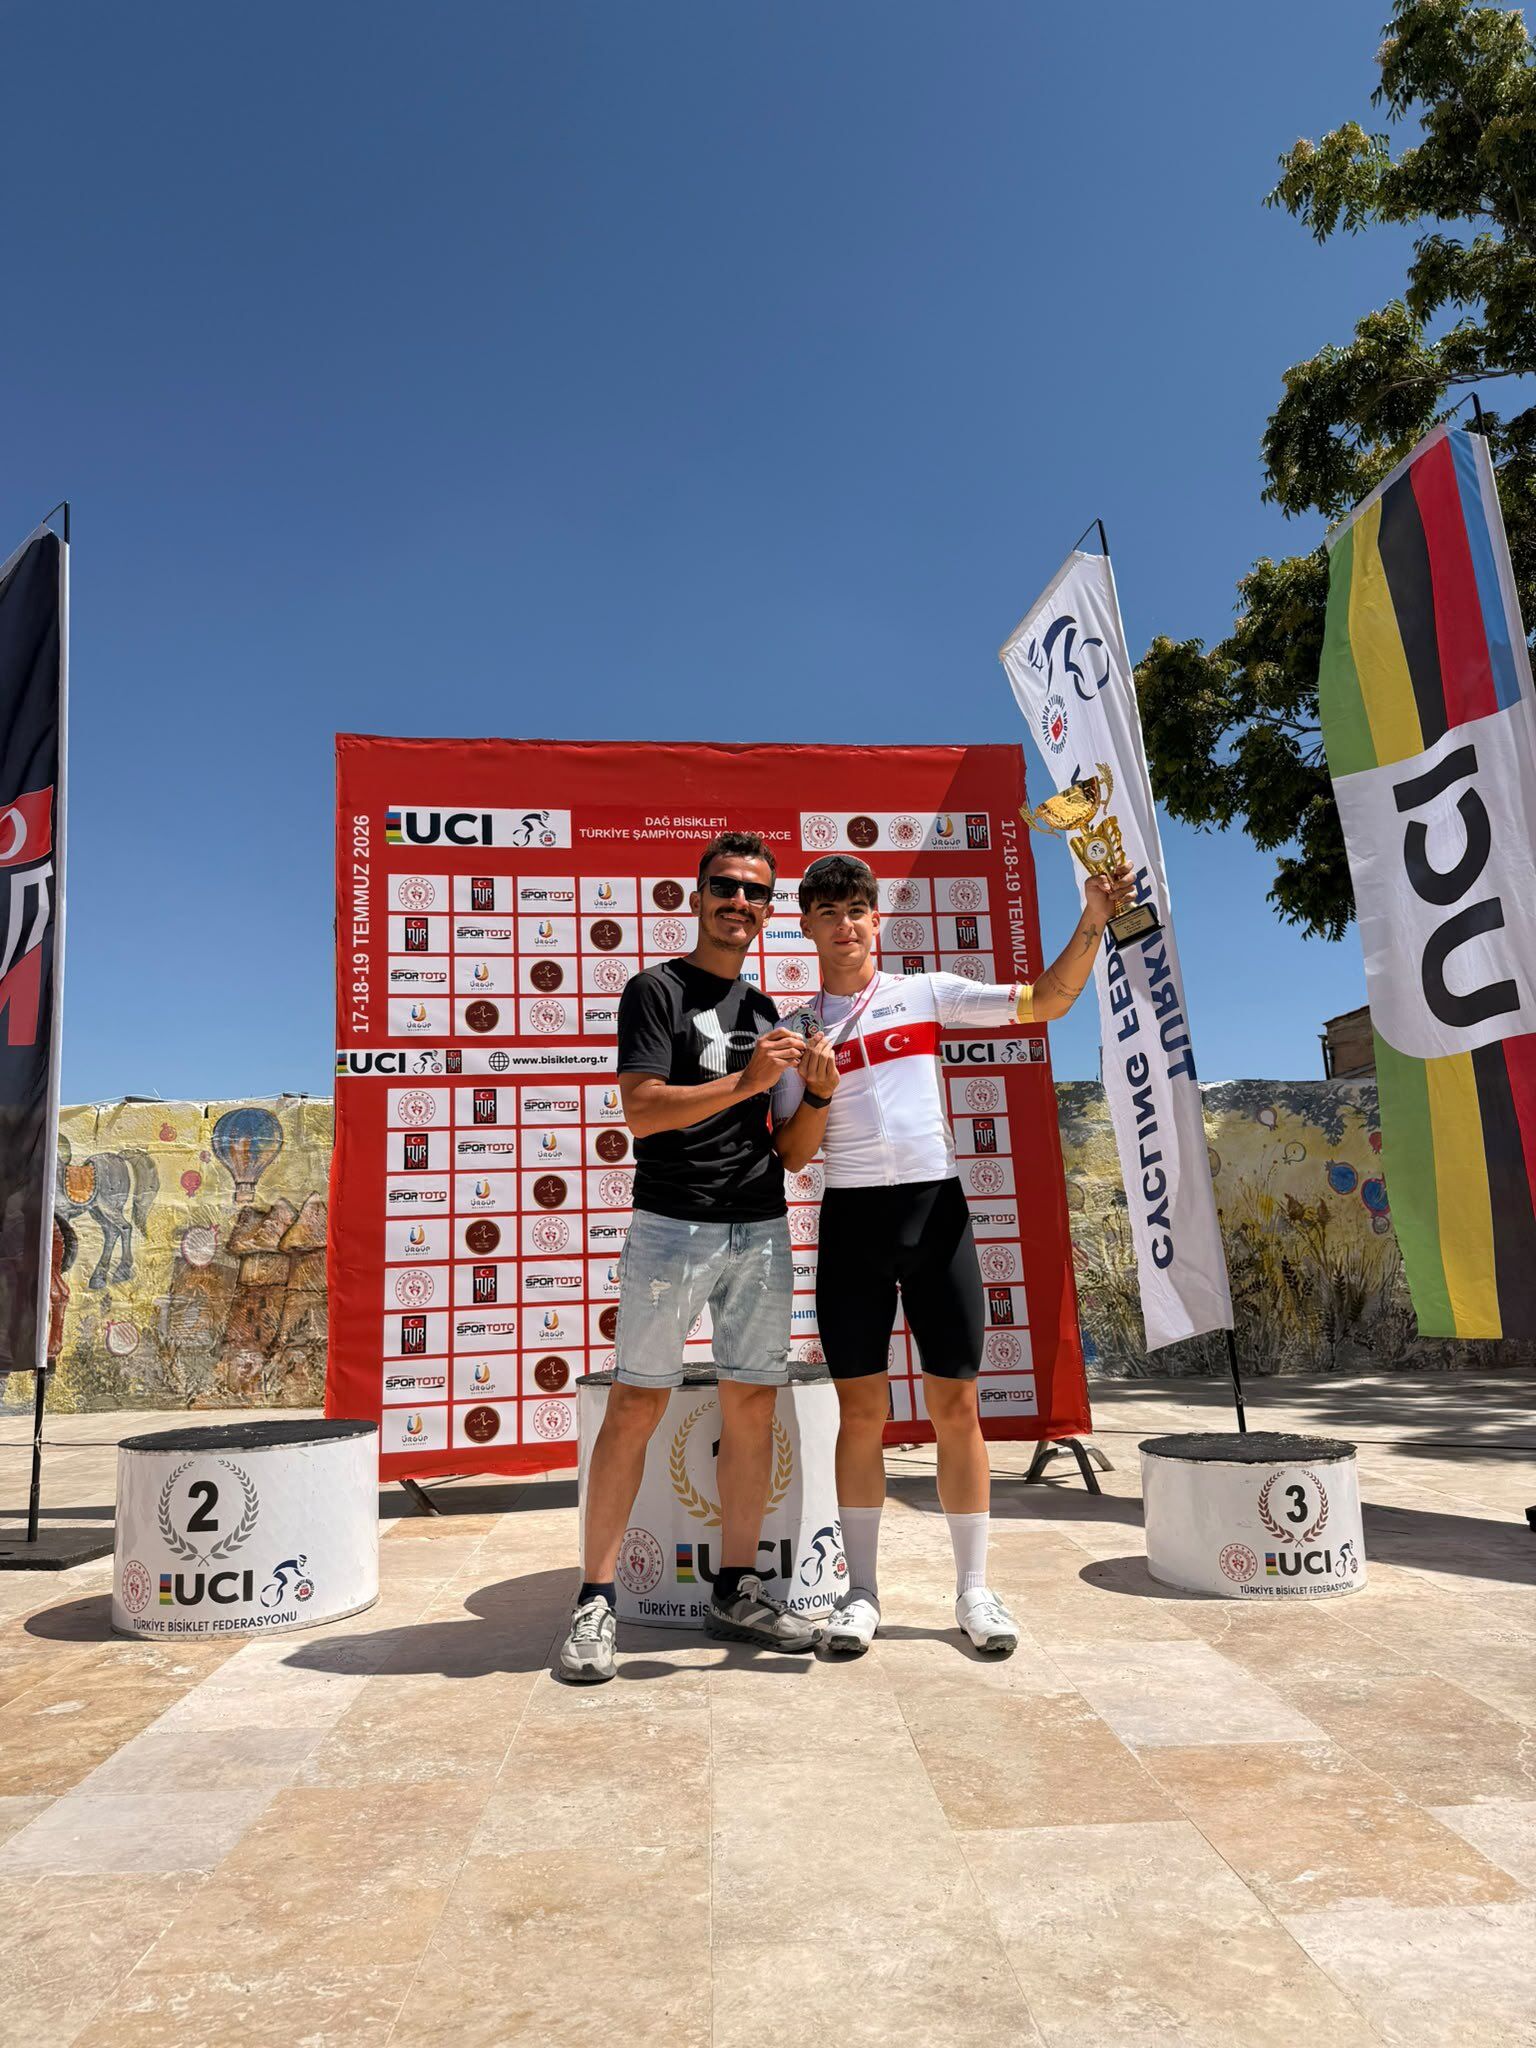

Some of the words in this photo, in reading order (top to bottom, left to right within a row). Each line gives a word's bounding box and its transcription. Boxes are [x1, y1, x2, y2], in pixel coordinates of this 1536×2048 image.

[405, 812, 492, 845] UCI
[645, 815, 670, 827] DAĞ
[673, 815, 727, 827] BİSİKLETİ
[353, 814, 370, 858] 2026
[579, 827, 630, 839] TÜRKİYE
[632, 828, 712, 841] ŞAMPİYONASI
[1001, 820, 1020, 892] 17-18-19
[353, 863, 370, 948] TEMMUZ
[765, 930, 803, 939] SHIMA
[1009, 897, 1029, 975] TEMMUZ
[352, 953, 369, 1033] 17-18-19
[585, 1011, 618, 1020] SPORT
[349, 1053, 406, 1074] UCI
[512, 1054, 609, 1066] www.bisiklet.org.tr
[944, 1042, 995, 1063] UCI
[970, 1213, 1016, 1223] PORTOTO
[186, 1481, 219, 1533] 2
[1285, 1485, 1308, 1523] 3
[1278, 1550, 1331, 1576] UCI
[174, 1570, 254, 1606] UCI
[1240, 1584, 1274, 1595] TÜRKİYE
[1276, 1585, 1308, 1595] BİSİKLET
[1309, 1580, 1354, 1594] FEDERASYONU
[638, 1599, 686, 1618] TÜRKİYE
[133, 1616, 165, 1632] TÜRKİYE
[167, 1618, 210, 1632] BİSİKLET
[213, 1610, 297, 1631] FEDERASYONU
